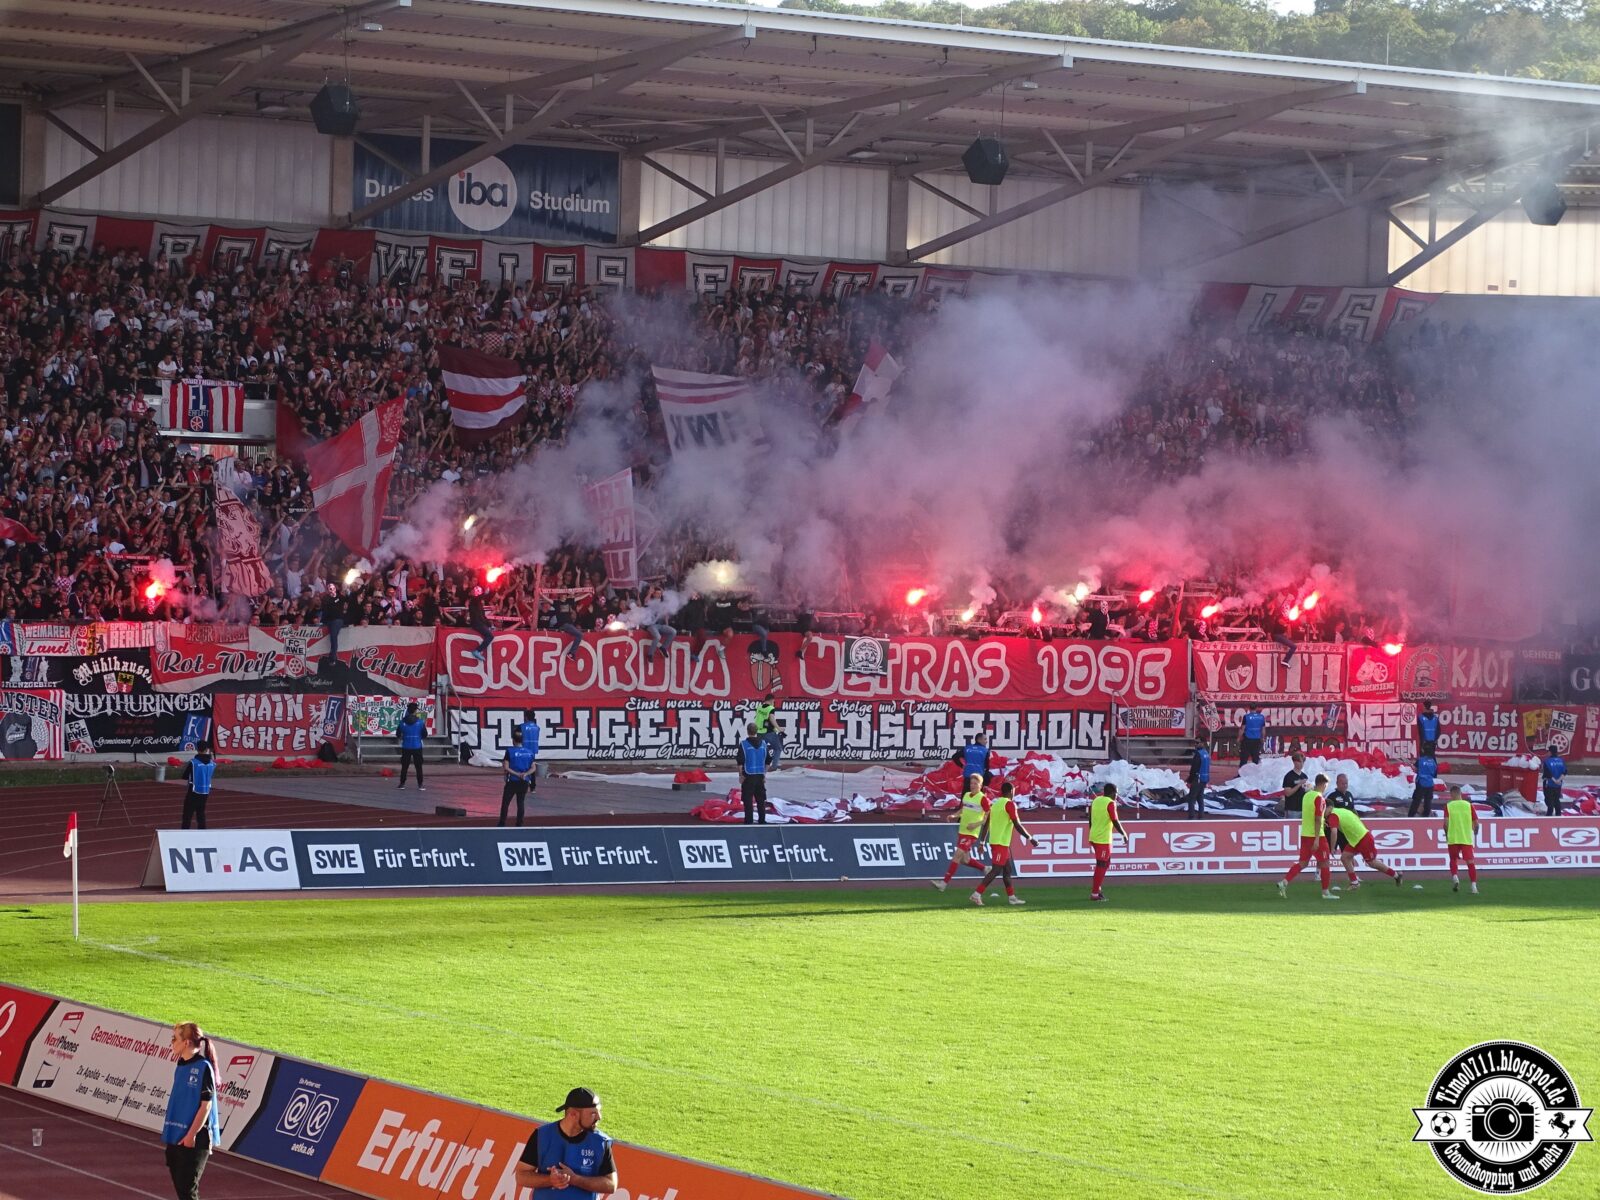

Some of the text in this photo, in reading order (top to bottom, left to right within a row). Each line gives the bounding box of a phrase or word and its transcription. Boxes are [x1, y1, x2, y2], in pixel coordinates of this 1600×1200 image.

[458, 171, 508, 208] iba
[530, 191, 611, 214] Studium
[376, 242, 627, 295] WEISS
[25, 625, 70, 638] WEIMARER
[110, 630, 154, 648] BERLIN
[27, 642, 69, 654] Land
[1521, 650, 1562, 660] GEHREN
[158, 651, 203, 673] Rot
[216, 650, 276, 680] Weiß
[357, 647, 426, 678] Erfurt
[1037, 644, 1173, 700] 1996
[1198, 652, 1343, 692] YOUTH
[0, 691, 60, 727] NSTER
[236, 694, 304, 722] MAIN
[626, 697, 660, 710] Einst
[667, 700, 702, 709] warst
[782, 700, 820, 711] unserer
[829, 699, 872, 716] Erfolge
[879, 700, 896, 713] und
[901, 699, 952, 715] Tränen,
[1224, 707, 1324, 727] LO CHICOS
[1492, 704, 1518, 727] ist
[1558, 712, 1572, 721] FC
[68, 722, 81, 732] FC
[1346, 702, 1417, 740] WEST
[1551, 720, 1575, 731] RWE
[217, 724, 326, 751] FIGHTER
[1436, 729, 1518, 751] ot-Weiß
[587, 744, 615, 759] nach
[623, 744, 646, 758] dem
[658, 743, 697, 759] Glanz
[783, 742, 822, 760] Tage
[827, 746, 863, 758] werden
[870, 748, 890, 758] wir
[897, 748, 915, 758] uns
[924, 747, 950, 760] ewig
[169, 846, 288, 873] NT.AG
[314, 848, 476, 868] SWE Für Erfurt.
[505, 845, 658, 866] SWE Für Erfurt.
[685, 843, 834, 863] SWE Für Erfurt.
[860, 843, 900, 861] SWE
[911, 843, 942, 861] Für
[91, 1025, 134, 1050] Gemeinsam
[132, 1039, 160, 1056] rocken
[159, 1044, 174, 1059] wir
[83, 1066, 100, 1081] Apolda
[104, 1073, 127, 1088] Arnstadt
[130, 1080, 147, 1094] Berlin
[150, 1086, 167, 1099] Erfurt
[76, 1084, 89, 1095] Jena
[92, 1087, 119, 1104] Meiningen
[123, 1095, 143, 1110] Weimar
[291, 1141, 316, 1157] aetka.de
[357, 1109, 495, 1200] Erfurt
